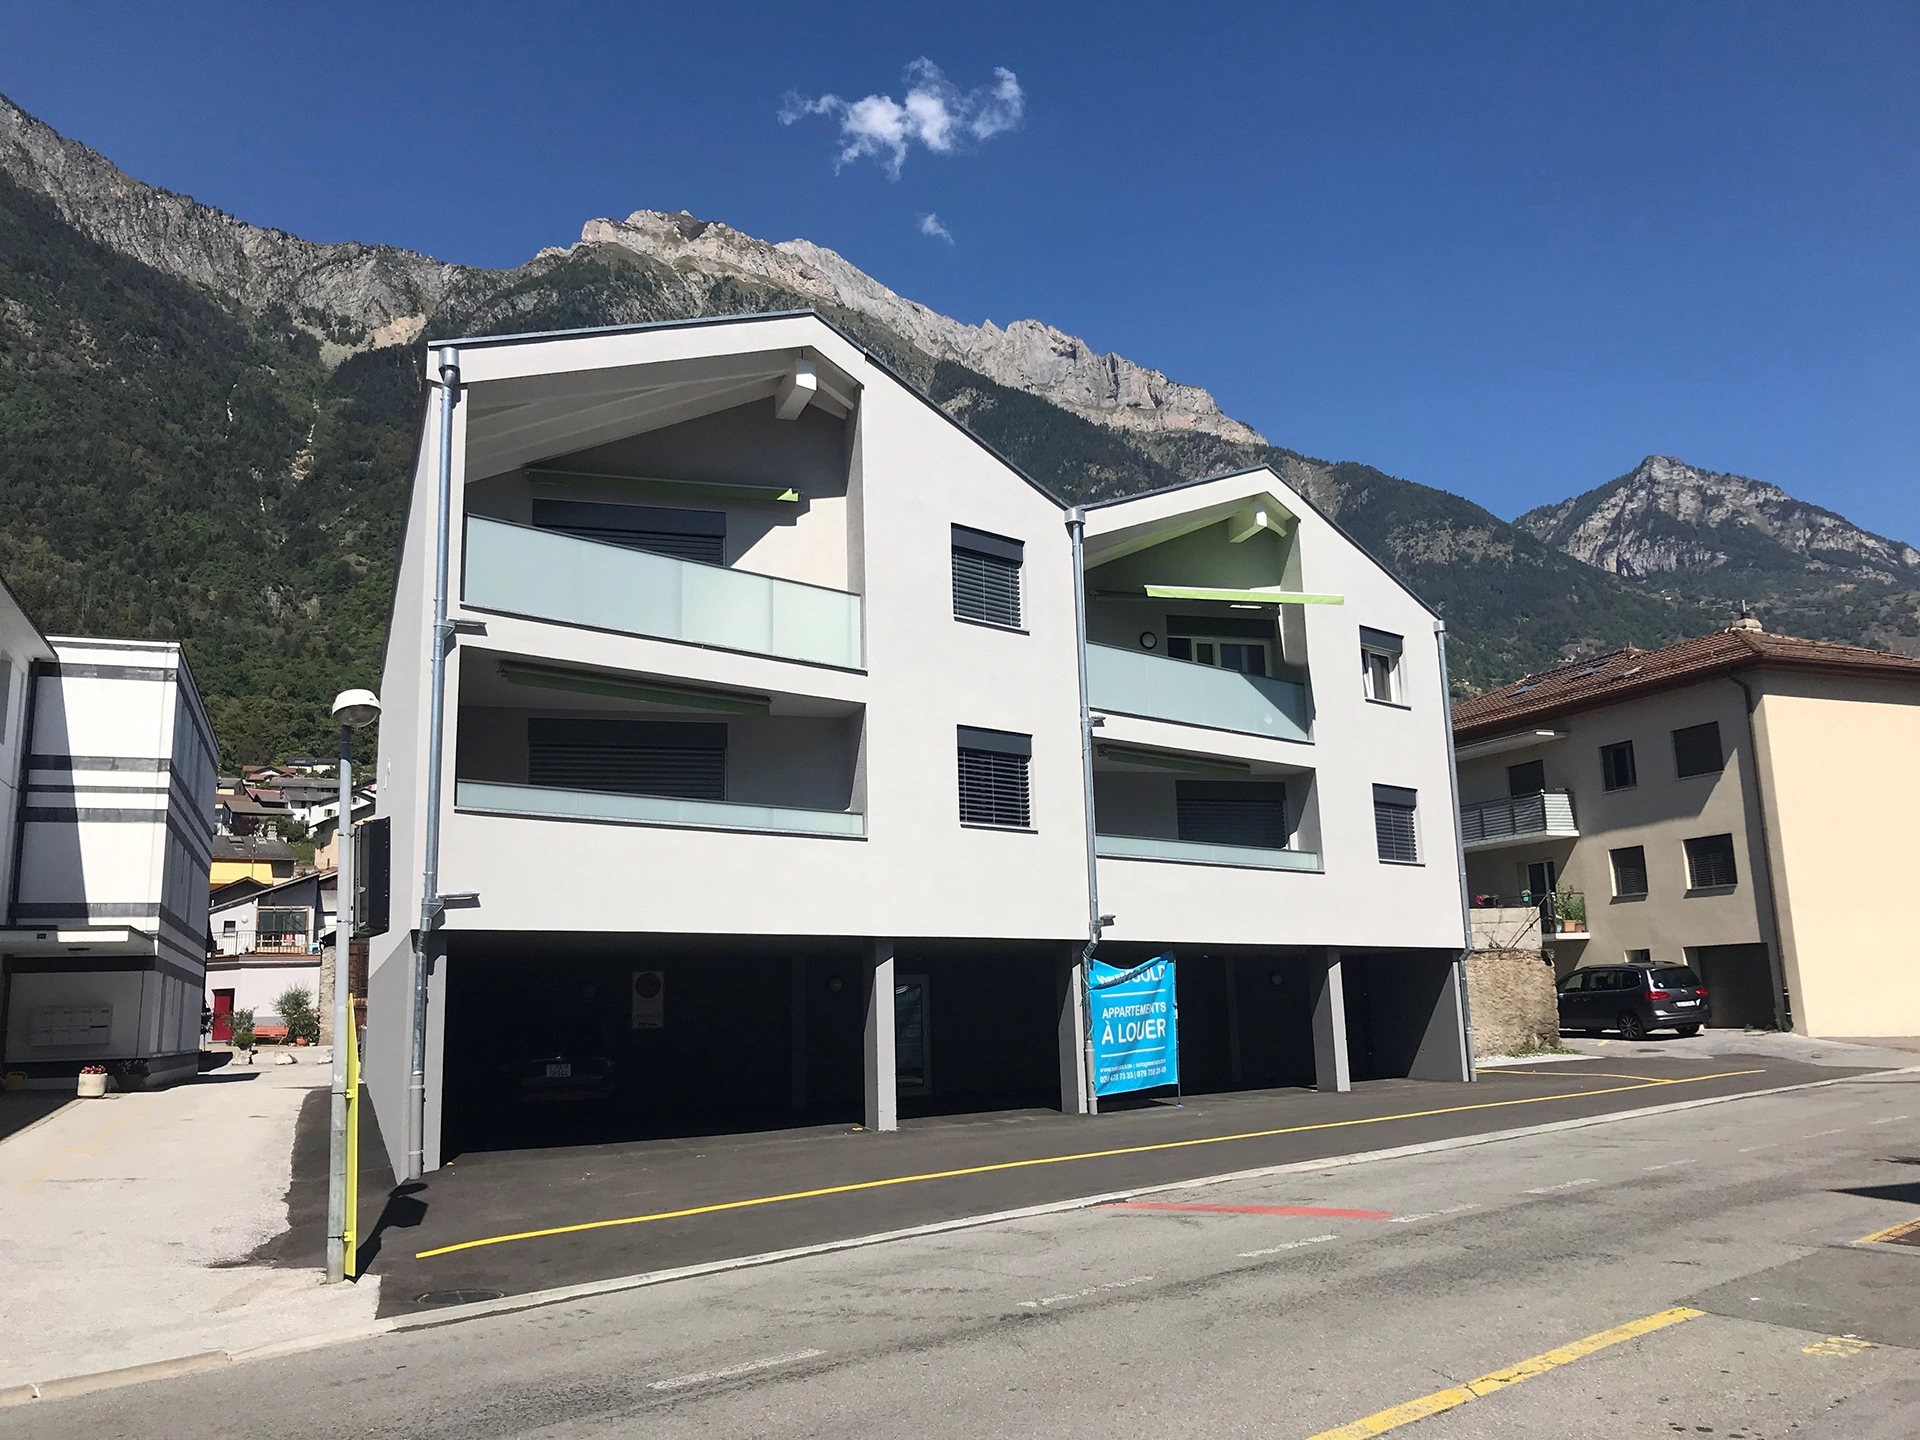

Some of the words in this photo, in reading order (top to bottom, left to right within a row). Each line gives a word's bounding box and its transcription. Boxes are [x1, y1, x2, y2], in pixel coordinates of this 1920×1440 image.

[1102, 1002, 1166, 1019] APPARTEMENTS
[1102, 1019, 1114, 1045] À
[1118, 1019, 1166, 1043] LOUER
